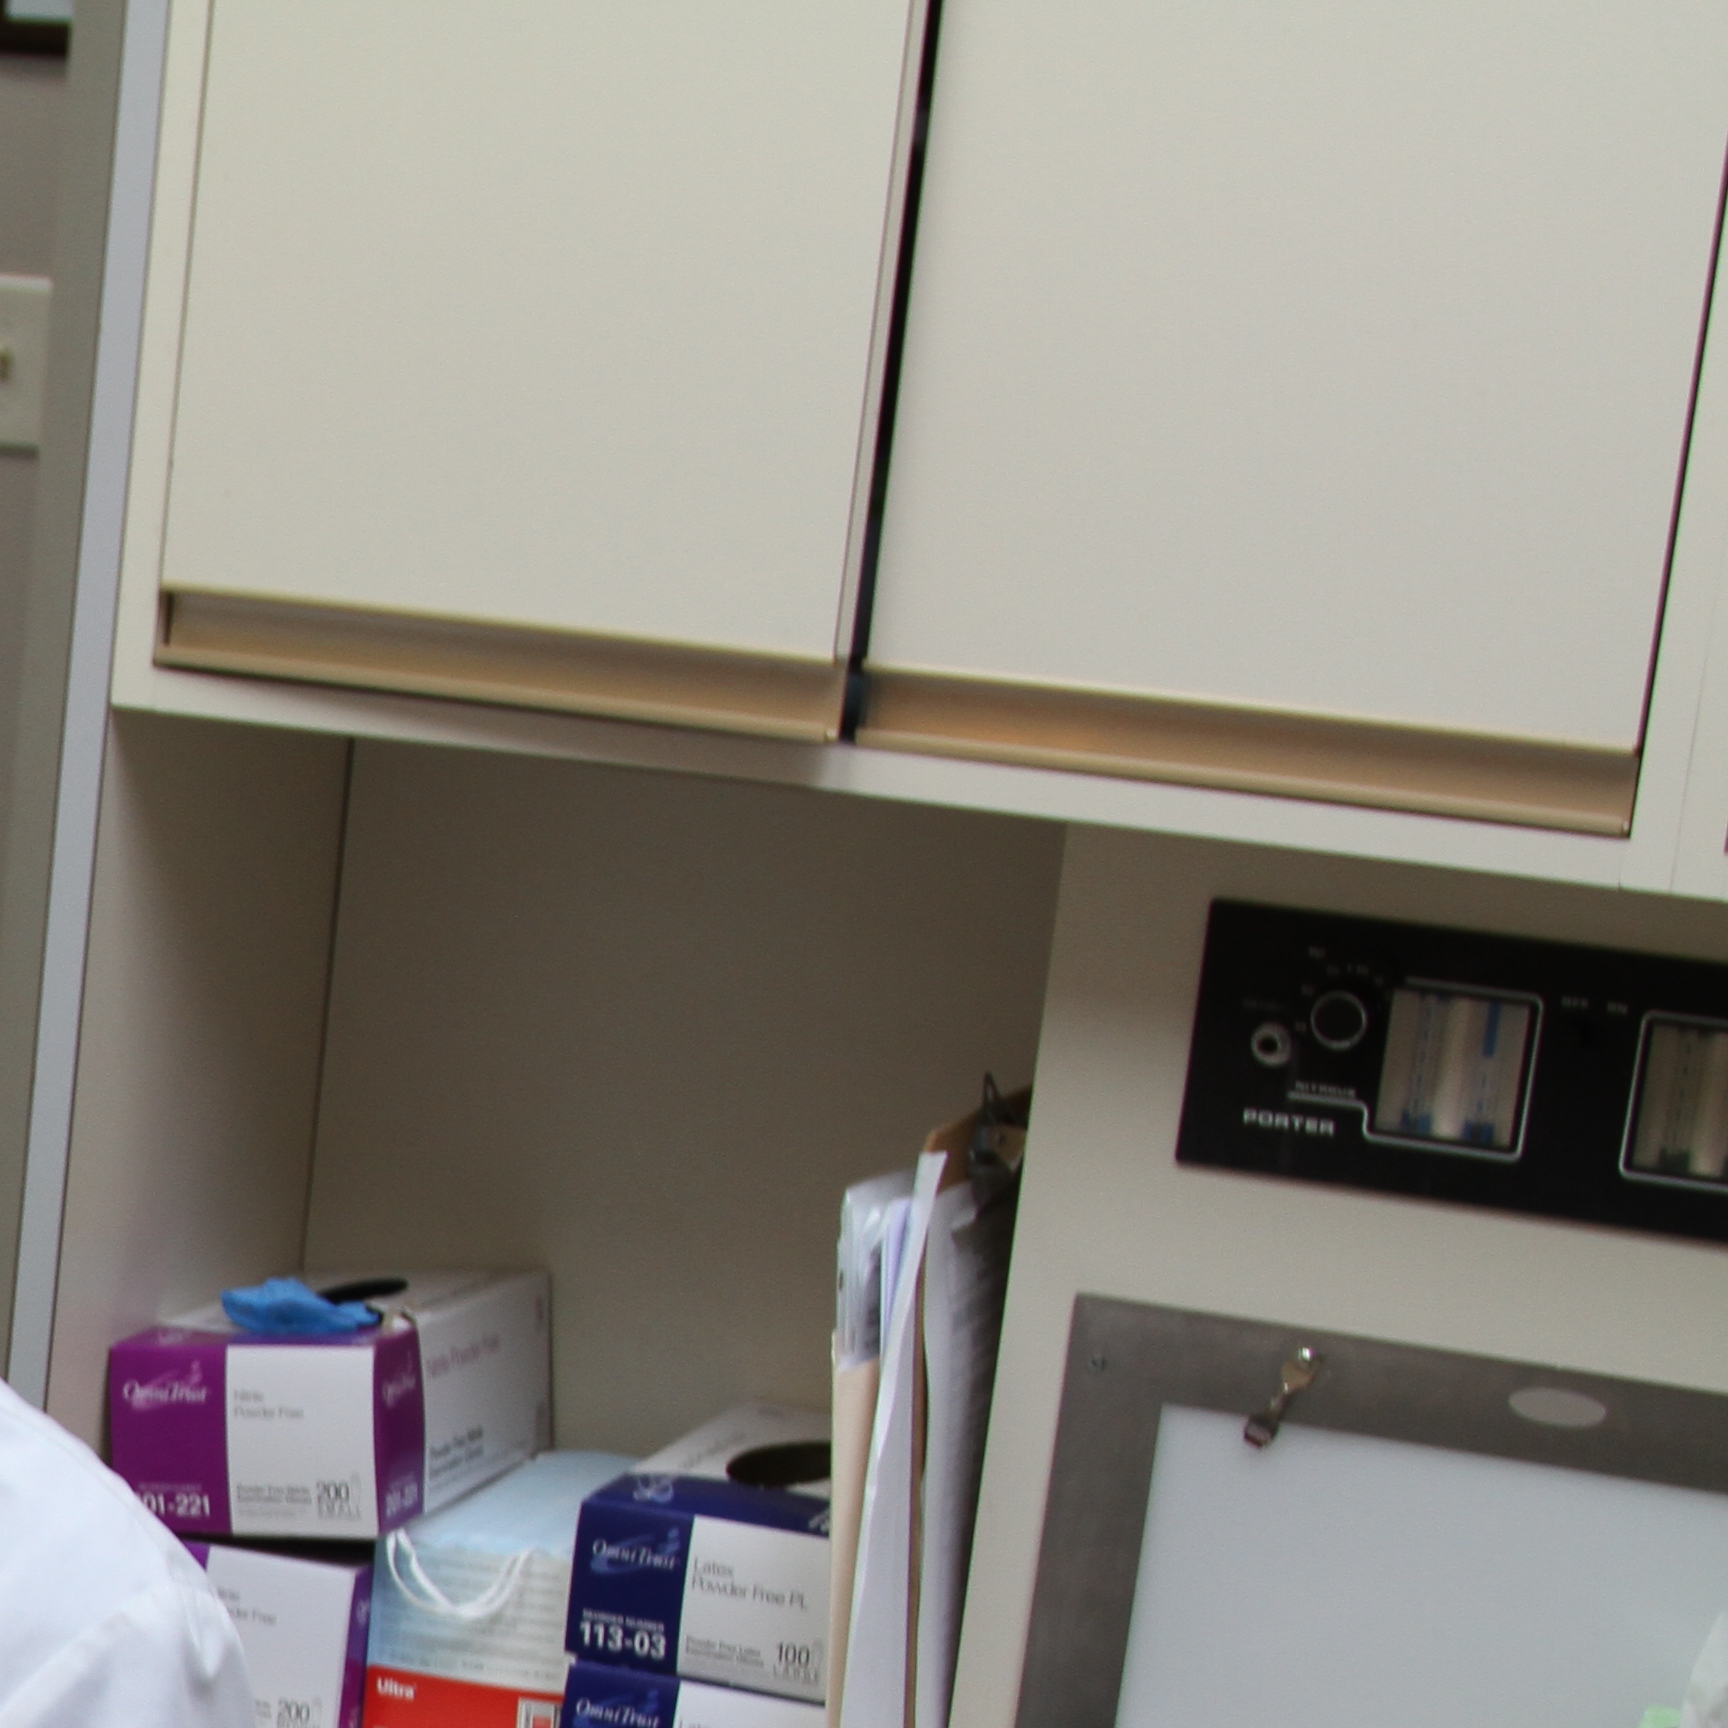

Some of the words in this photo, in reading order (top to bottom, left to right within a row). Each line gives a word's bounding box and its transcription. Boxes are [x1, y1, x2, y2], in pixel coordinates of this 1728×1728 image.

[1243, 1106, 1335, 1138] PORTER
[316, 1480, 350, 1501] 200
[593, 1538, 677, 1570] OmniTrust
[694, 1557, 734, 1576] Latex
[692, 1575, 747, 1598] Powder
[753, 1585, 785, 1608] Free
[790, 1592, 807, 1611] PL
[579, 1619, 666, 1660] 113-03
[777, 1641, 811, 1668] 100
[376, 1676, 416, 1699] Ultra
[278, 1698, 311, 1723] 200
